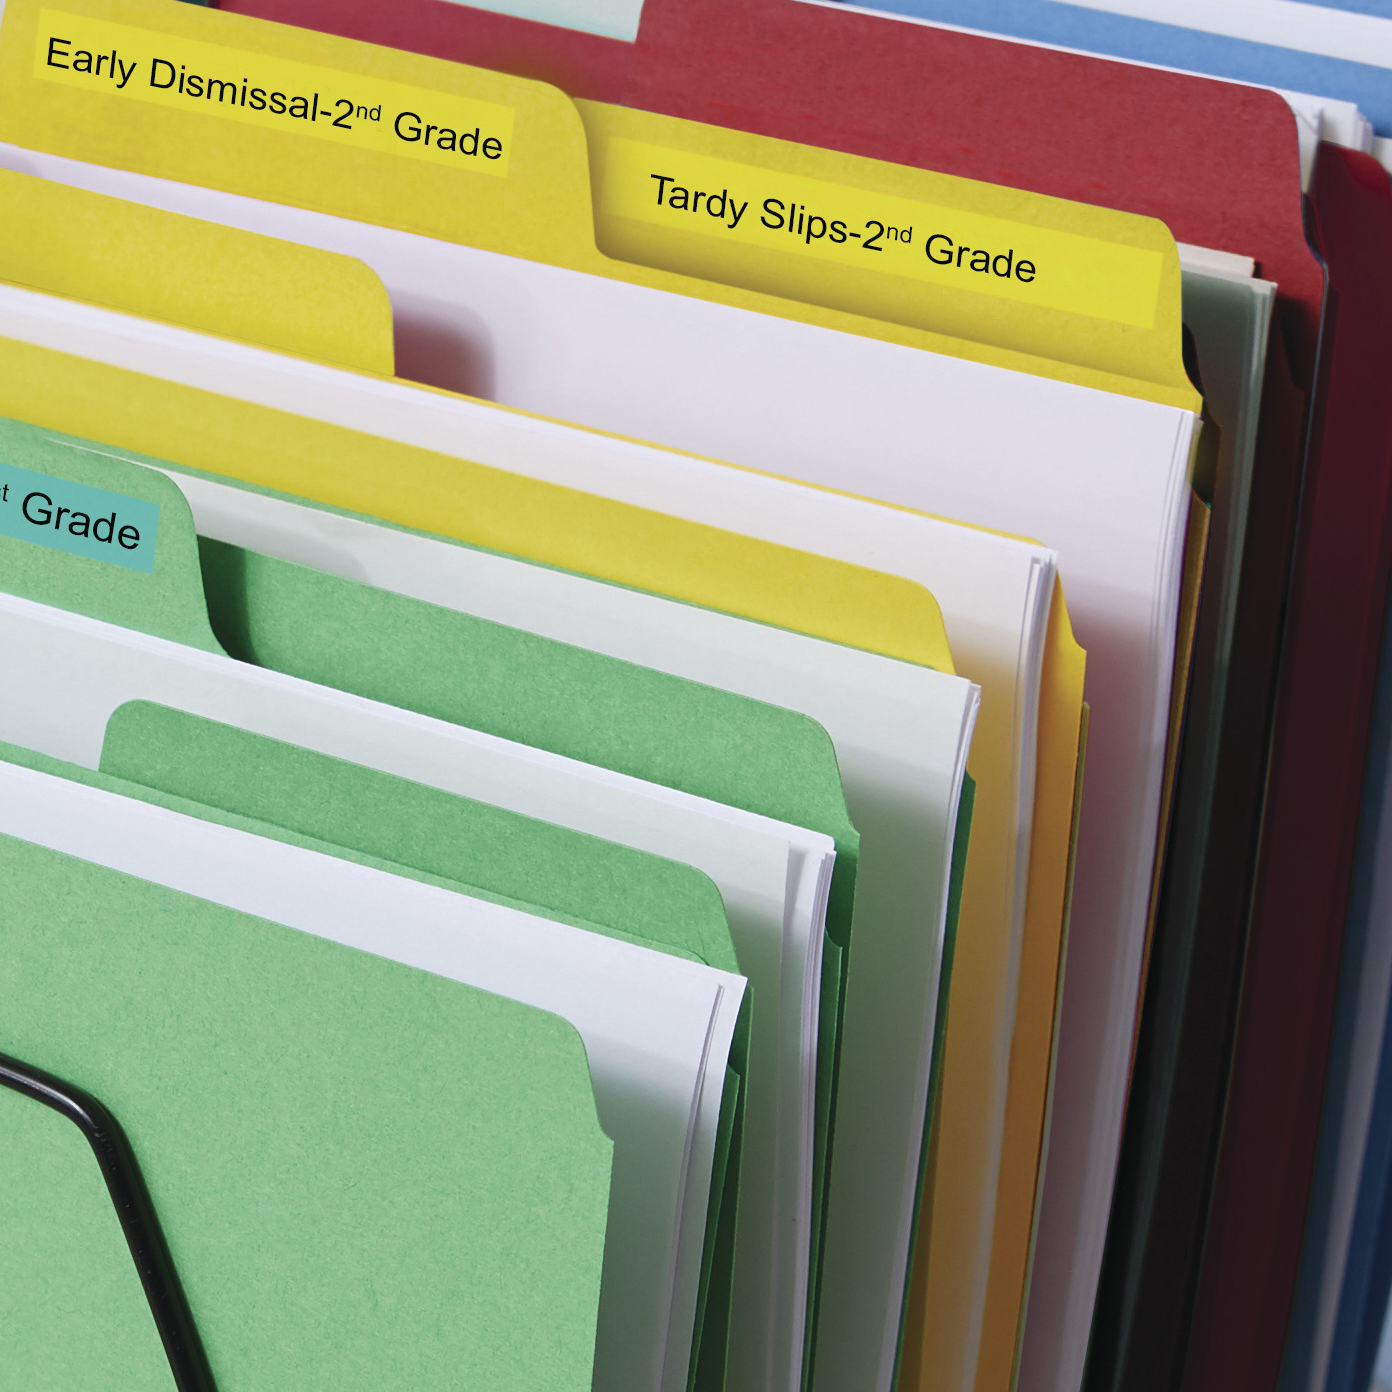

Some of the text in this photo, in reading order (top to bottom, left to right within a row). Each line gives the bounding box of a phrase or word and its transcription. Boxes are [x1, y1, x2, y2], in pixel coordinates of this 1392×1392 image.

[45, 36, 504, 161] Early Dismissal-2nd Grade
[649, 172, 1037, 284] Tardy Slips-2nd Grade
[21, 490, 141, 551] Grade
